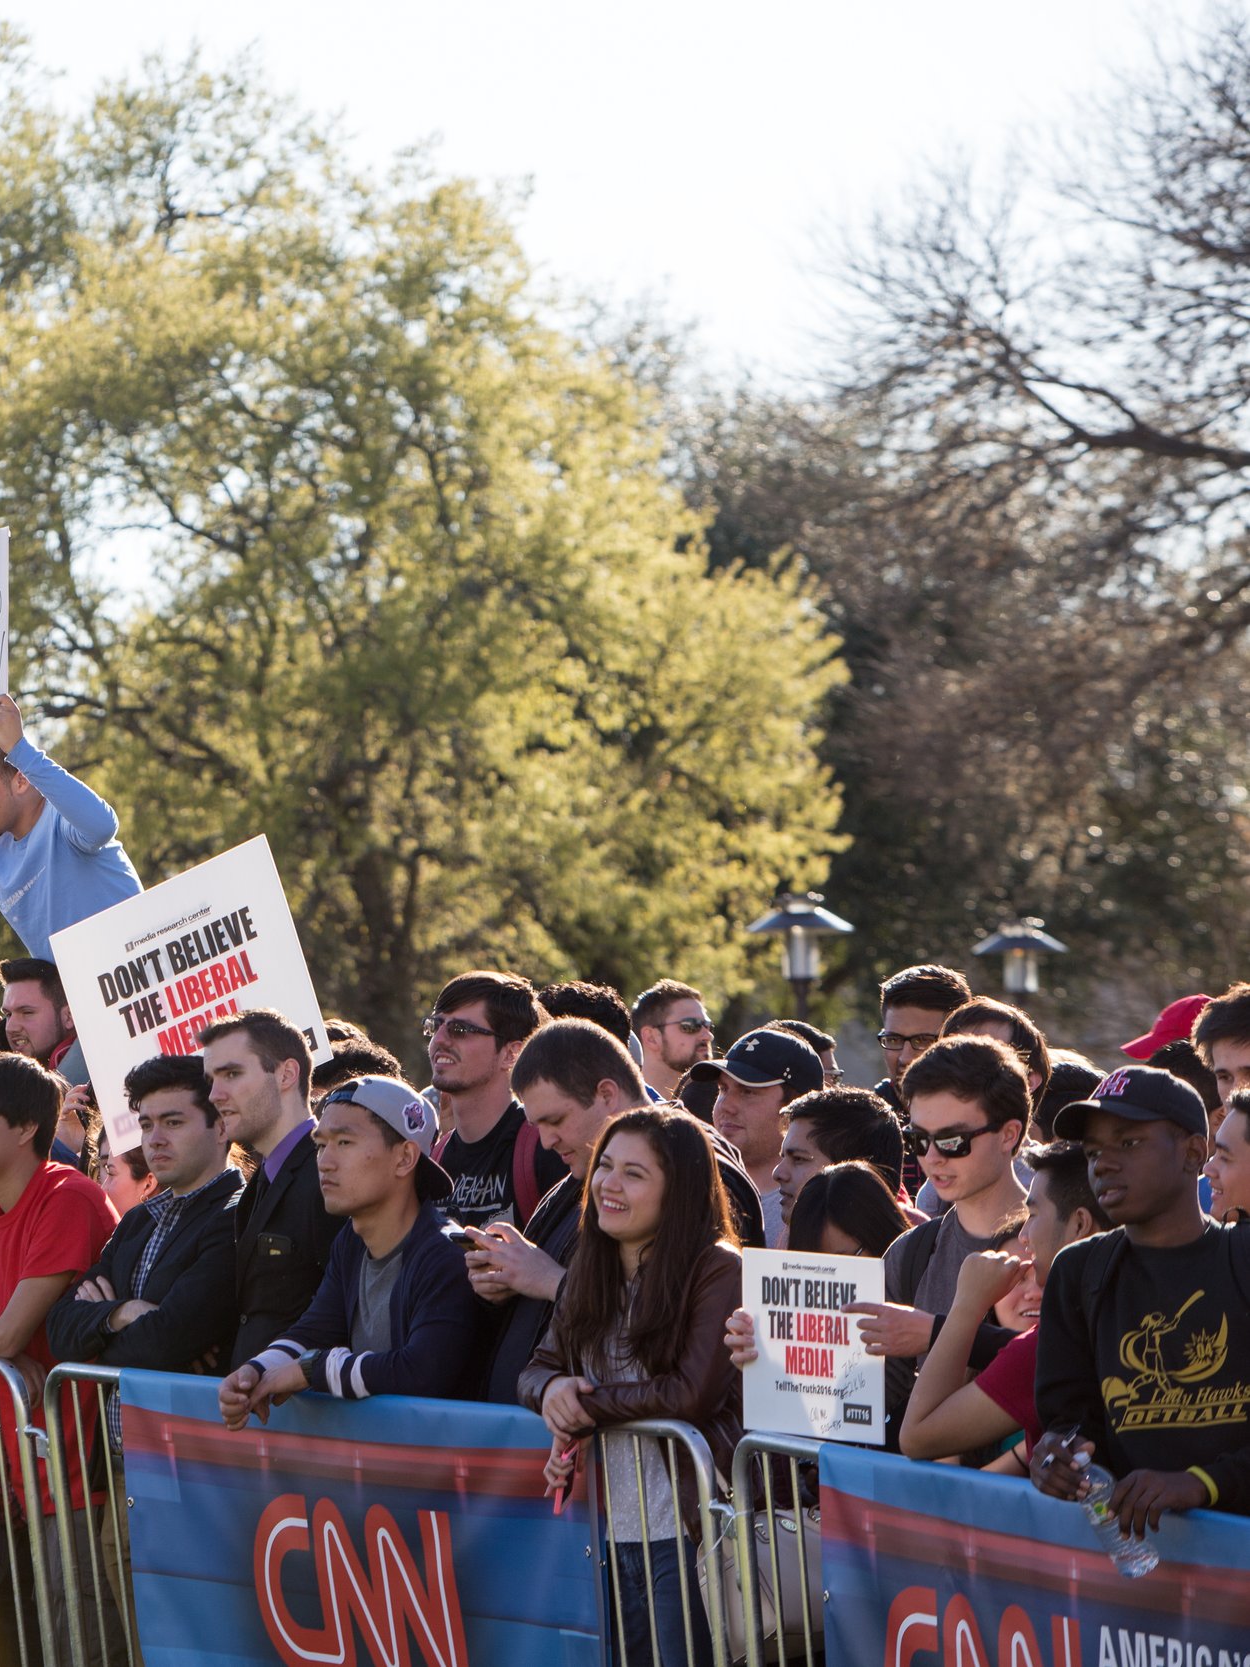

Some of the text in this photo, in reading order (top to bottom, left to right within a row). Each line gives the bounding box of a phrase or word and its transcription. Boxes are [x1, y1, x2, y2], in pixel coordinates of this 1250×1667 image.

[133, 932, 156, 947] media
[156, 917, 187, 937] research
[187, 906, 211, 921] center
[96, 905, 258, 1008] DON'T BELIEVE
[118, 949, 259, 1039] THE LIBERAL
[761, 1276, 857, 1310] DON'T BELIEVE
[768, 1310, 850, 1346] THE LIBERAL
[785, 1345, 834, 1379] MEDIA!
[774, 1380, 845, 1400] TellTheTruth2016.org
[845, 1407, 870, 1421] #TTT16
[254, 1494, 468, 1667] CNN
